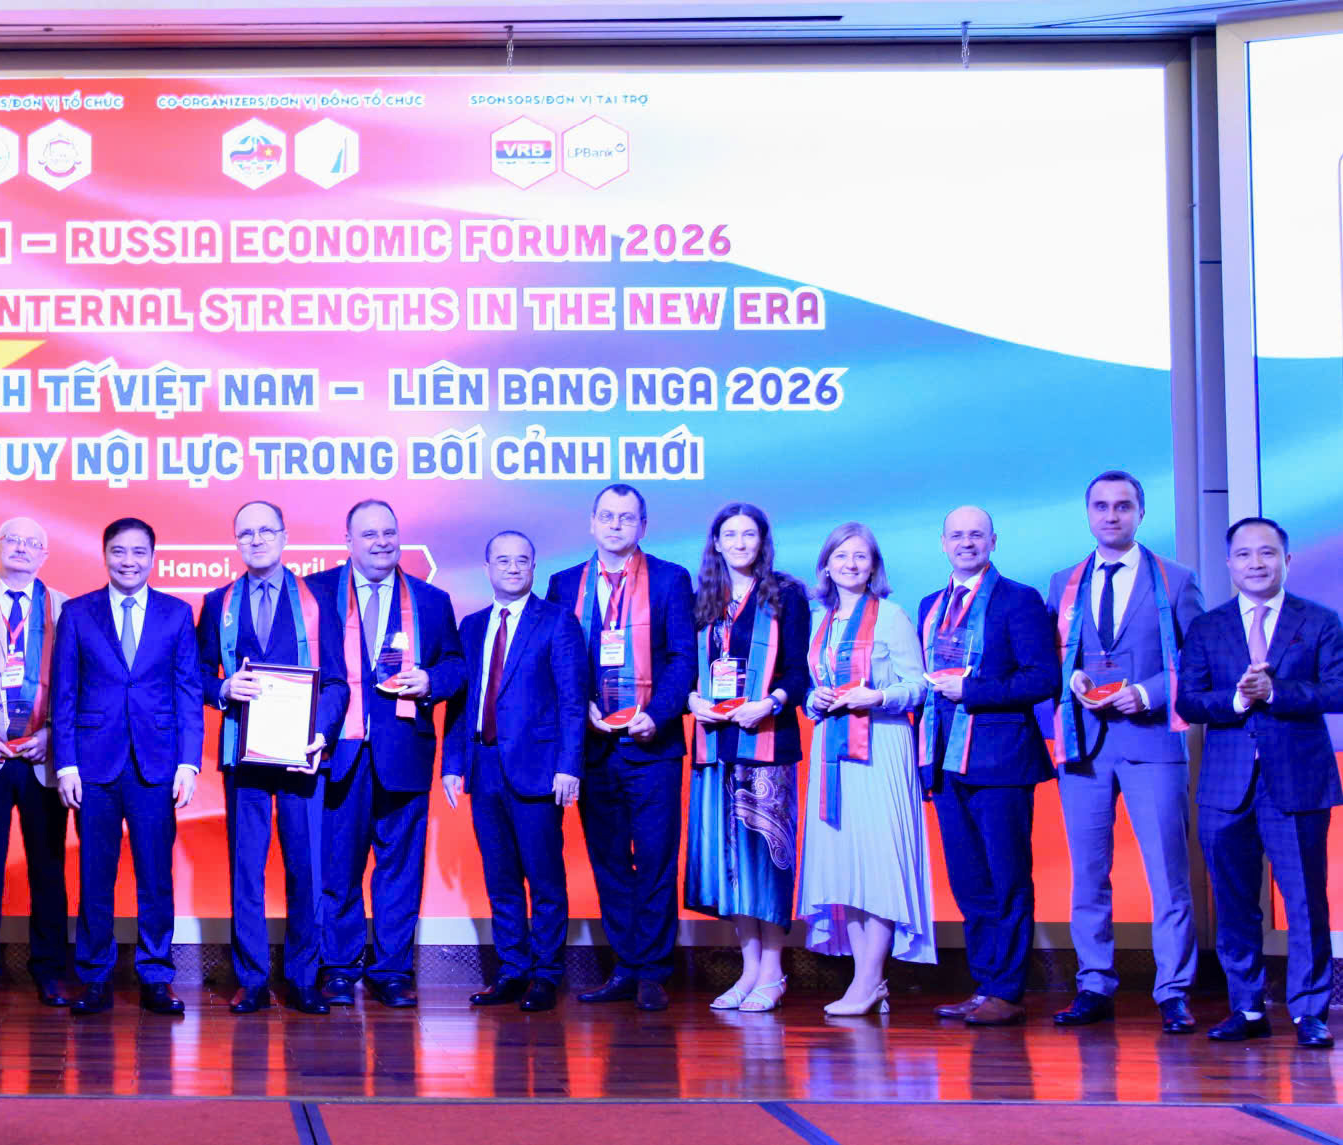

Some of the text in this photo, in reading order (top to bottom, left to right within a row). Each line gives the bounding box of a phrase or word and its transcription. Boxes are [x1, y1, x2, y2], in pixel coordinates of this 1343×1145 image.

[504, 143, 546, 156] VRB
[71, 226, 217, 258] RUSSIA
[235, 225, 447, 257] ECONOMIC
[465, 224, 607, 257] FORUM
[626, 224, 731, 256] 2026
[206, 293, 455, 326] STRENGTHS
[473, 293, 511, 325] IN
[529, 293, 610, 325] THE
[629, 293, 720, 325] NEW
[740, 292, 819, 325] ERA
[44, 364, 111, 406] TẾ
[113, 366, 206, 414] VIỆT
[224, 374, 314, 406] NAM
[394, 366, 483, 406] LIÊN
[504, 373, 612, 406] BANG
[632, 373, 712, 406] NGA
[732, 373, 838, 406] 2026
[76, 435, 143, 482] NỘI
[162, 439, 238, 482] LỰC
[255, 442, 393, 475] TRONG
[412, 432, 479, 475] BỐI
[496, 430, 604, 475] CẢNH
[624, 431, 698, 475] MỚI
[158, 557, 238, 580] Hanoi,
